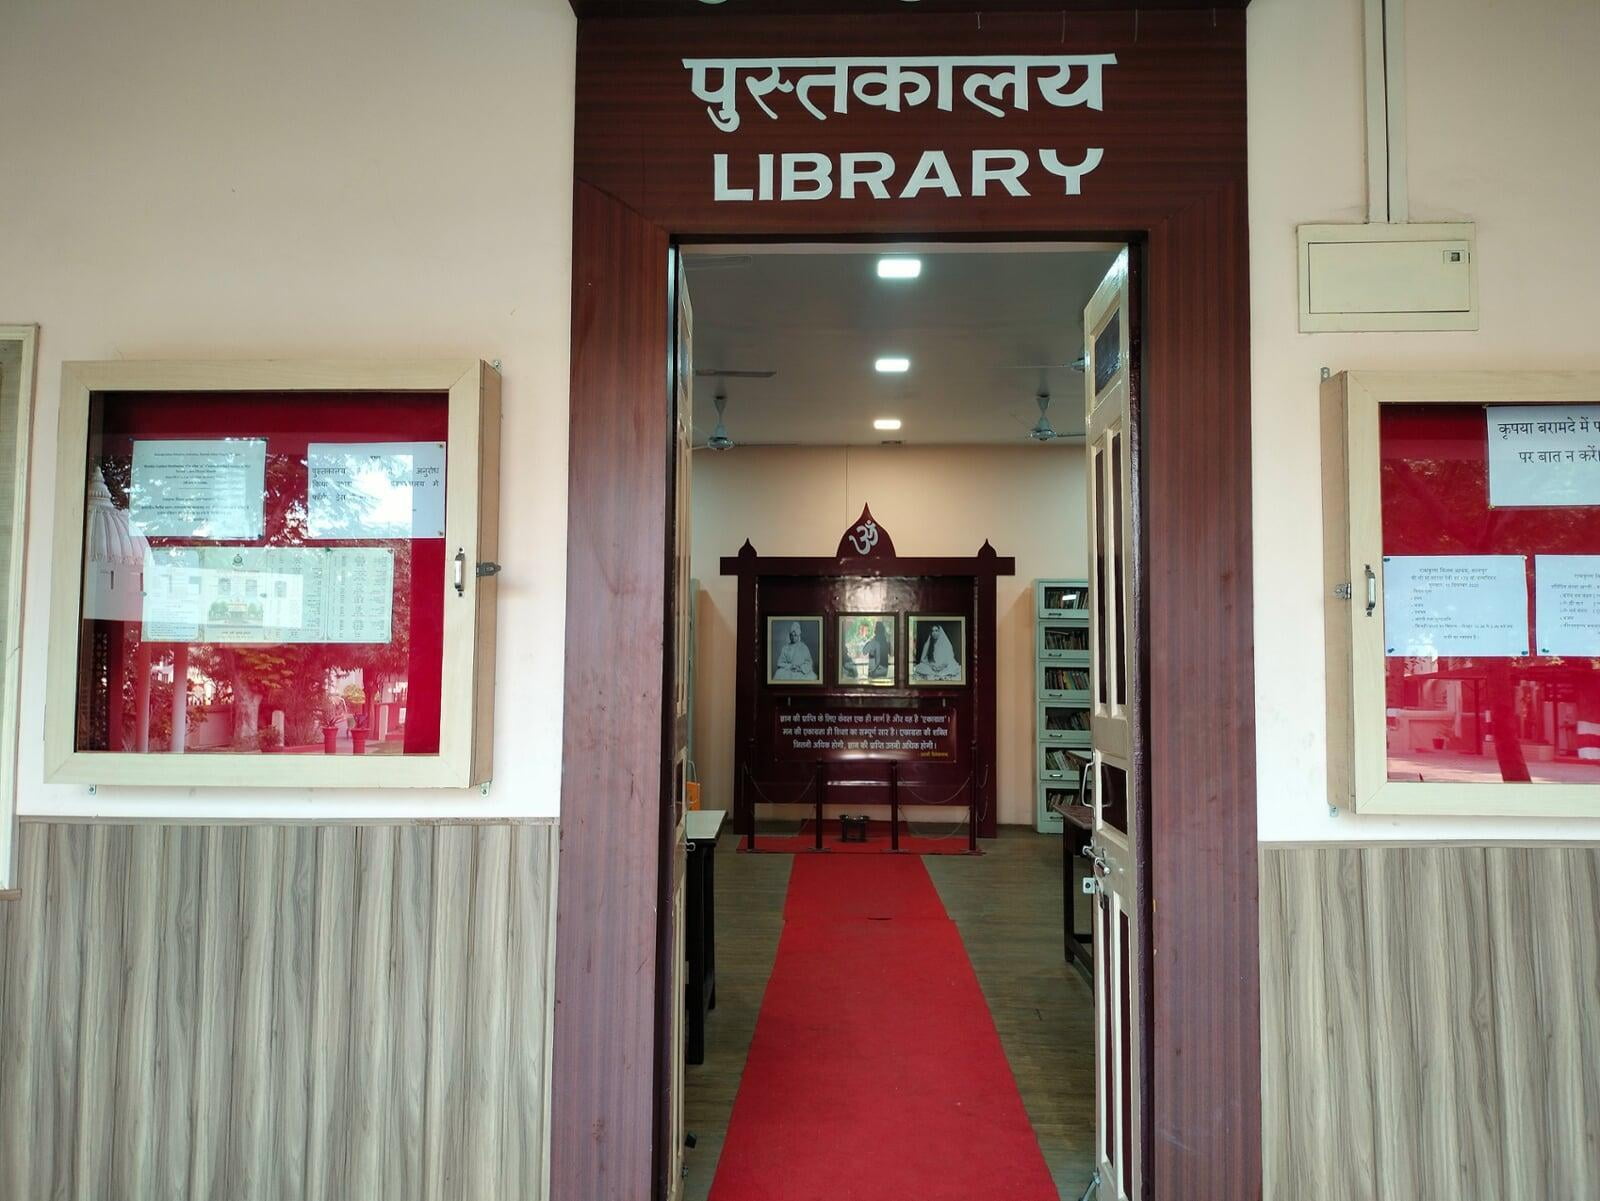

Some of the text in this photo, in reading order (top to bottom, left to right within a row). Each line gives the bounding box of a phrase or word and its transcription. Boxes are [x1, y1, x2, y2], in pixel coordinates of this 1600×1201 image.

[681, 53, 1118, 133] पुस्तकालय
[713, 147, 1104, 201] LIBRARY
[1497, 422, 1534, 440] कृपया
[1537, 416, 1575, 434] बरामदे
[1579, 416, 1589, 432] में
[1519, 452, 1534, 463] पर
[1537, 450, 1562, 463] बात
[1565, 450, 1574, 462] न
[416, 466, 440, 478] अनुरोध
